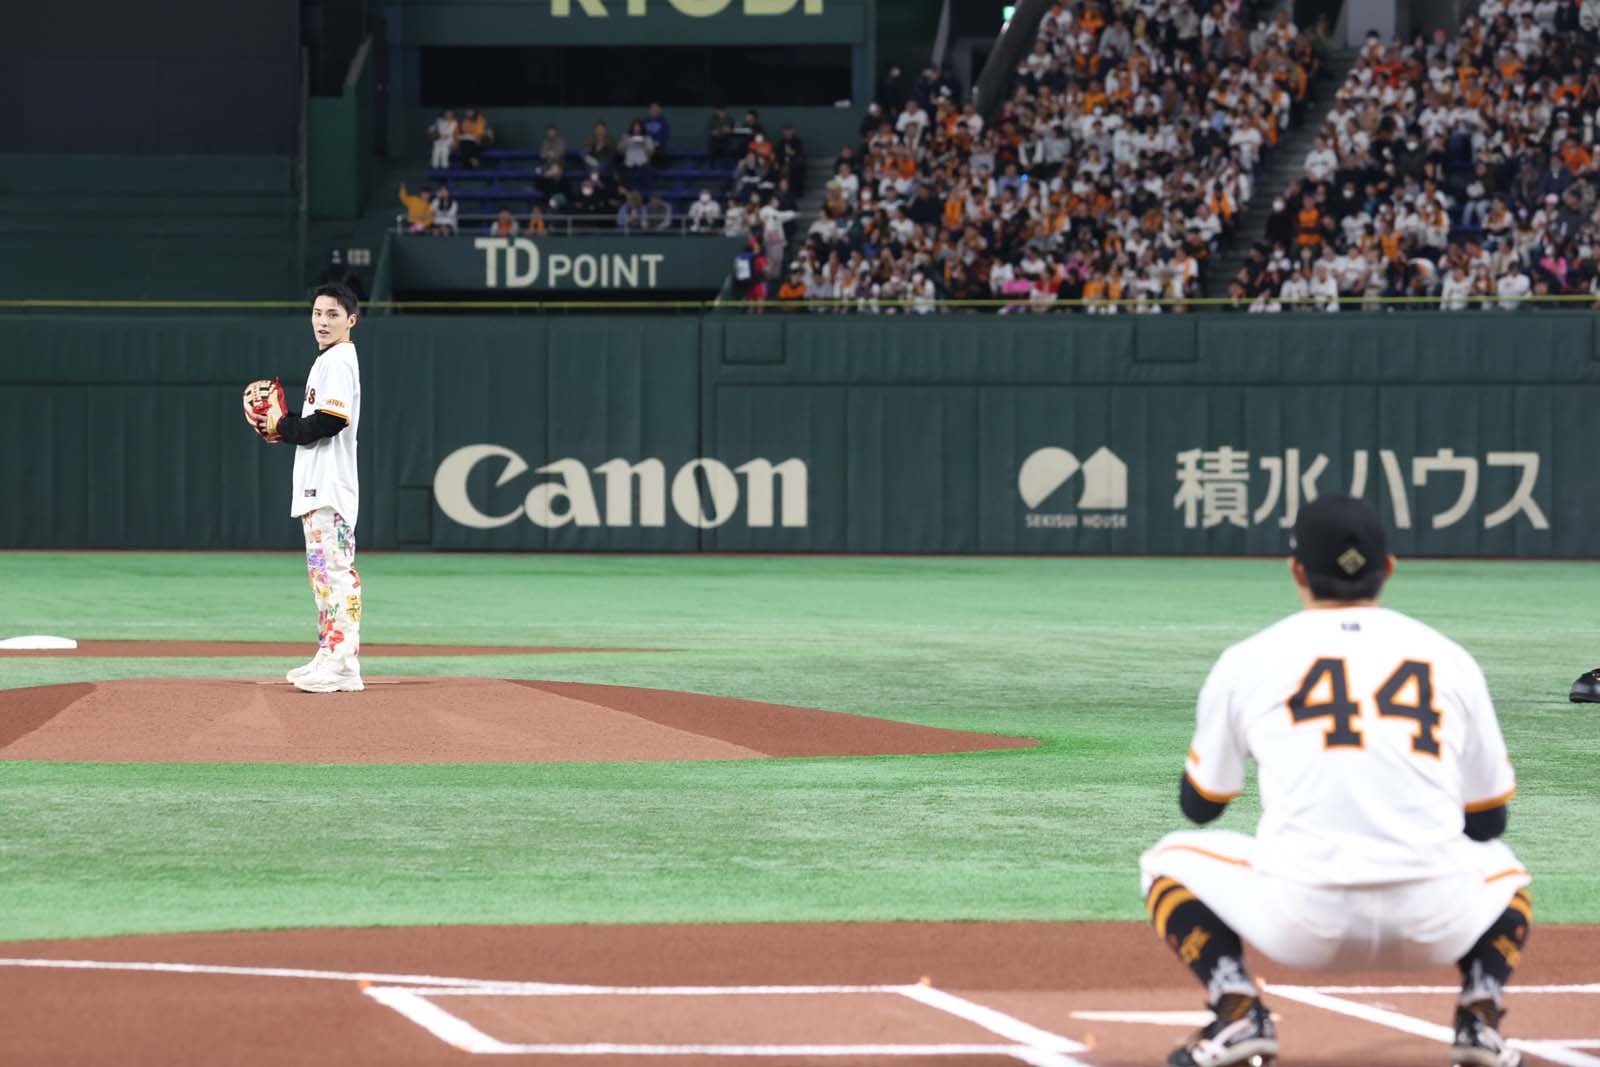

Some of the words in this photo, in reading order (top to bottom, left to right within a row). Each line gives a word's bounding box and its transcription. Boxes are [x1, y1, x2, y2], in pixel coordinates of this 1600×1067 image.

[474, 237, 540, 288] TD
[548, 253, 665, 288] POINT
[433, 443, 809, 530] Canon
[1025, 513, 1078, 529] SEKISUI
[1082, 513, 1128, 529] HOUSE
[1173, 446, 1550, 530] 積水ハウス
[1284, 656, 1443, 760] 44
